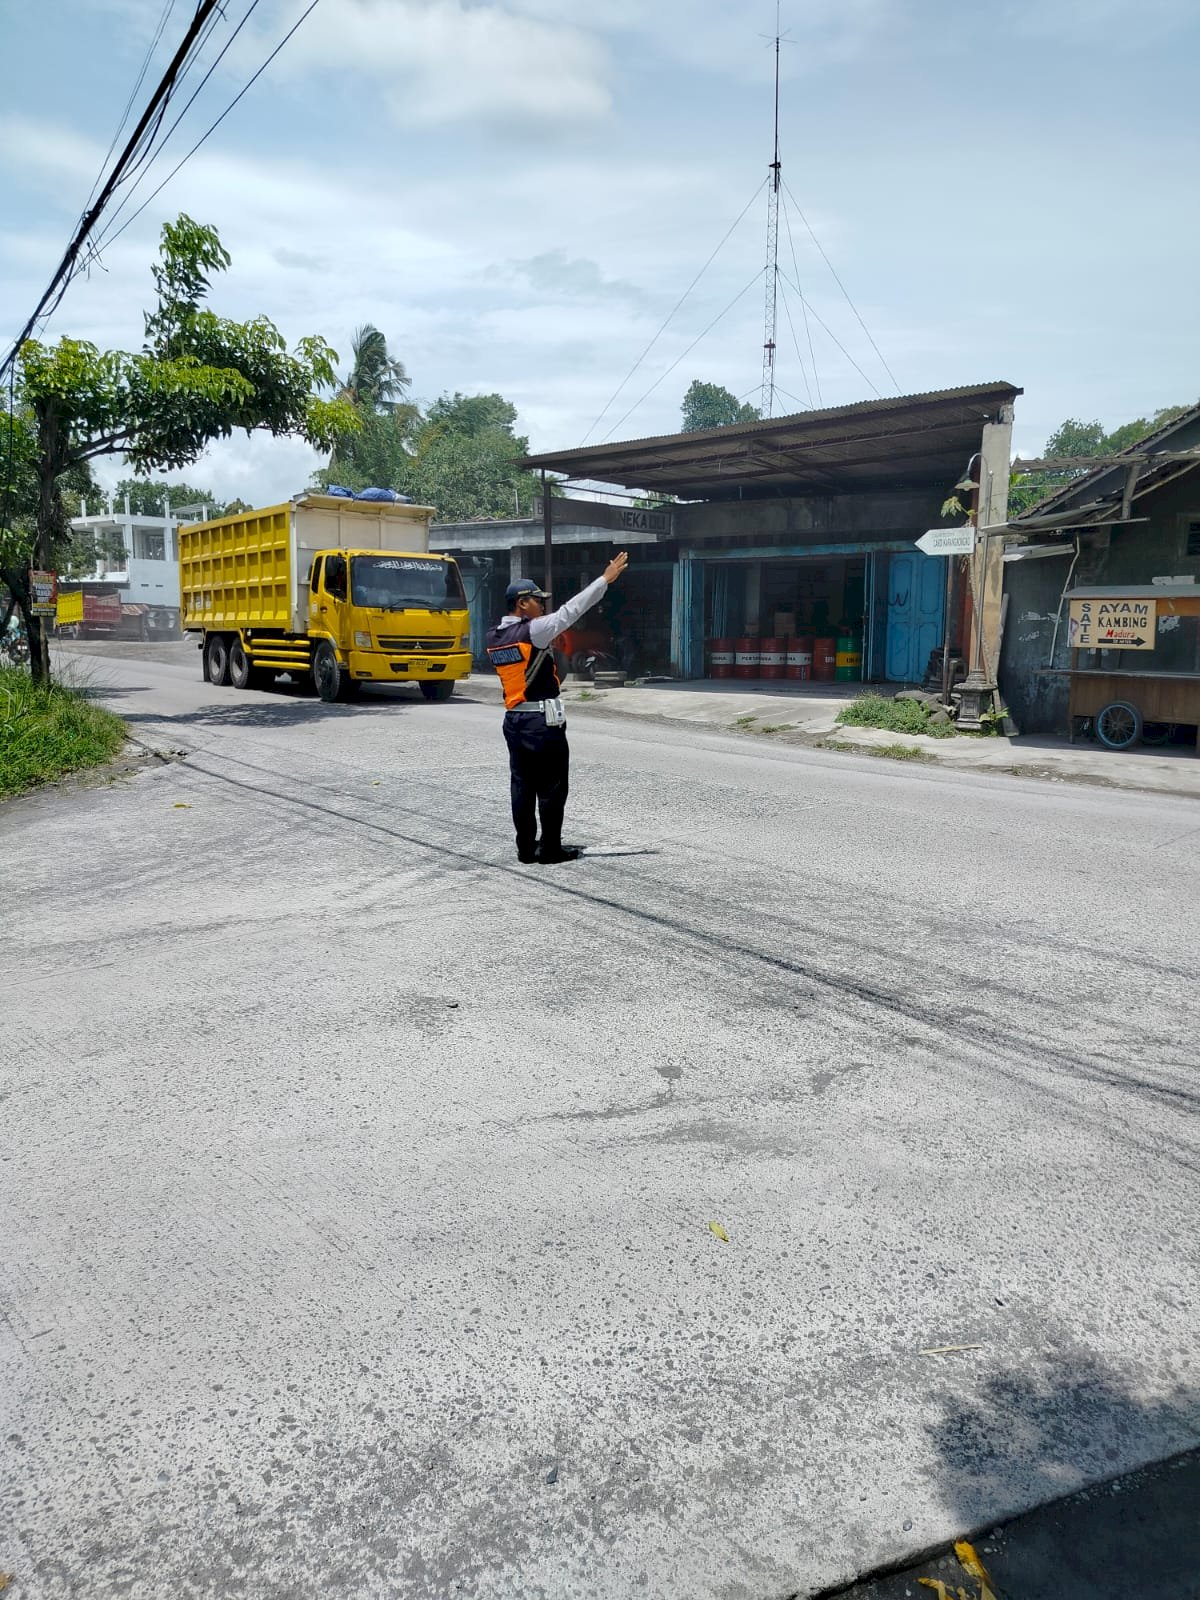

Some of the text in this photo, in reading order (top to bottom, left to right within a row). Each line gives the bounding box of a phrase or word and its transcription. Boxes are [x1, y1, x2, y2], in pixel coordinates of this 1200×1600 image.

[1099, 603, 1149, 615] AYAM
[1080, 603, 1092, 643] SATE
[1098, 617, 1148, 628] KAMBING
[1105, 629, 1136, 639] Madura
